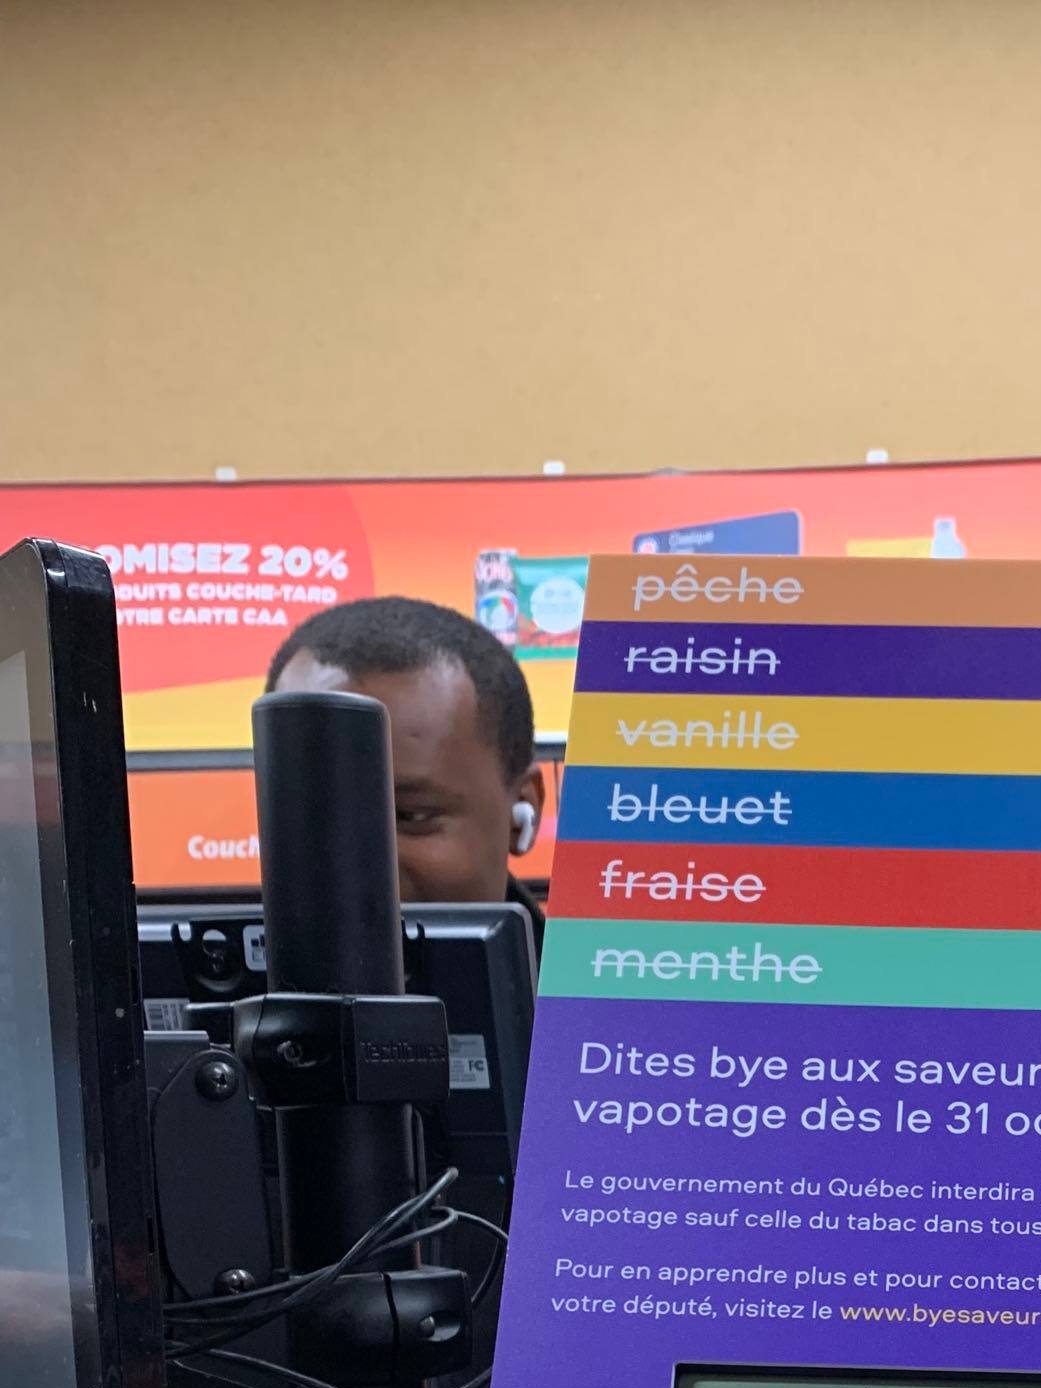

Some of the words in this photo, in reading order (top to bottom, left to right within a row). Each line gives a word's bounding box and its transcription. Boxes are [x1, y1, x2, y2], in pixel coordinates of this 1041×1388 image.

[258, 545, 349, 581] 20%
[186, 582, 338, 605] COUCHE-TARD
[633, 564, 804, 611] pêche
[168, 607, 238, 625] CARTE
[243, 608, 288, 626] CAA
[624, 637, 781, 676] raisin
[616, 711, 799, 749] vanille
[608, 784, 792, 825] bleuet
[600, 860, 766, 902] fraise
[592, 942, 822, 984] menthe
[579, 1041, 696, 1078] Dites
[710, 1046, 789, 1088] bye
[801, 1057, 881, 1083] aux
[573, 1097, 787, 1138] vapotage
[800, 1096, 882, 1133] dès
[895, 1100, 932, 1134] le
[945, 1102, 990, 1135] 31
[565, 1170, 594, 1189] Le
[600, 1174, 784, 1195] gouvernement
[790, 1177, 821, 1196] du
[828, 1176, 924, 1200] Québec
[931, 1181, 1035, 1202] interdira
[561, 1207, 678, 1229] vapotage
[684, 1208, 739, 1228] sauf
[744, 1210, 802, 1229] celle
[808, 1211, 839, 1230] du
[847, 1213, 917, 1232] tabac
[924, 1214, 984, 1234] dans
[555, 1259, 613, 1279] Pour
[620, 1264, 650, 1280] en
[658, 1264, 788, 1285] apprendre
[795, 1266, 847, 1288] plus
[853, 1270, 878, 1287] et
[885, 1274, 943, 1291] pour
[551, 1296, 617, 1313] votre
[623, 1294, 717, 1320] député,
[724, 1298, 805, 1319] visitez
[812, 1300, 833, 1320] le
